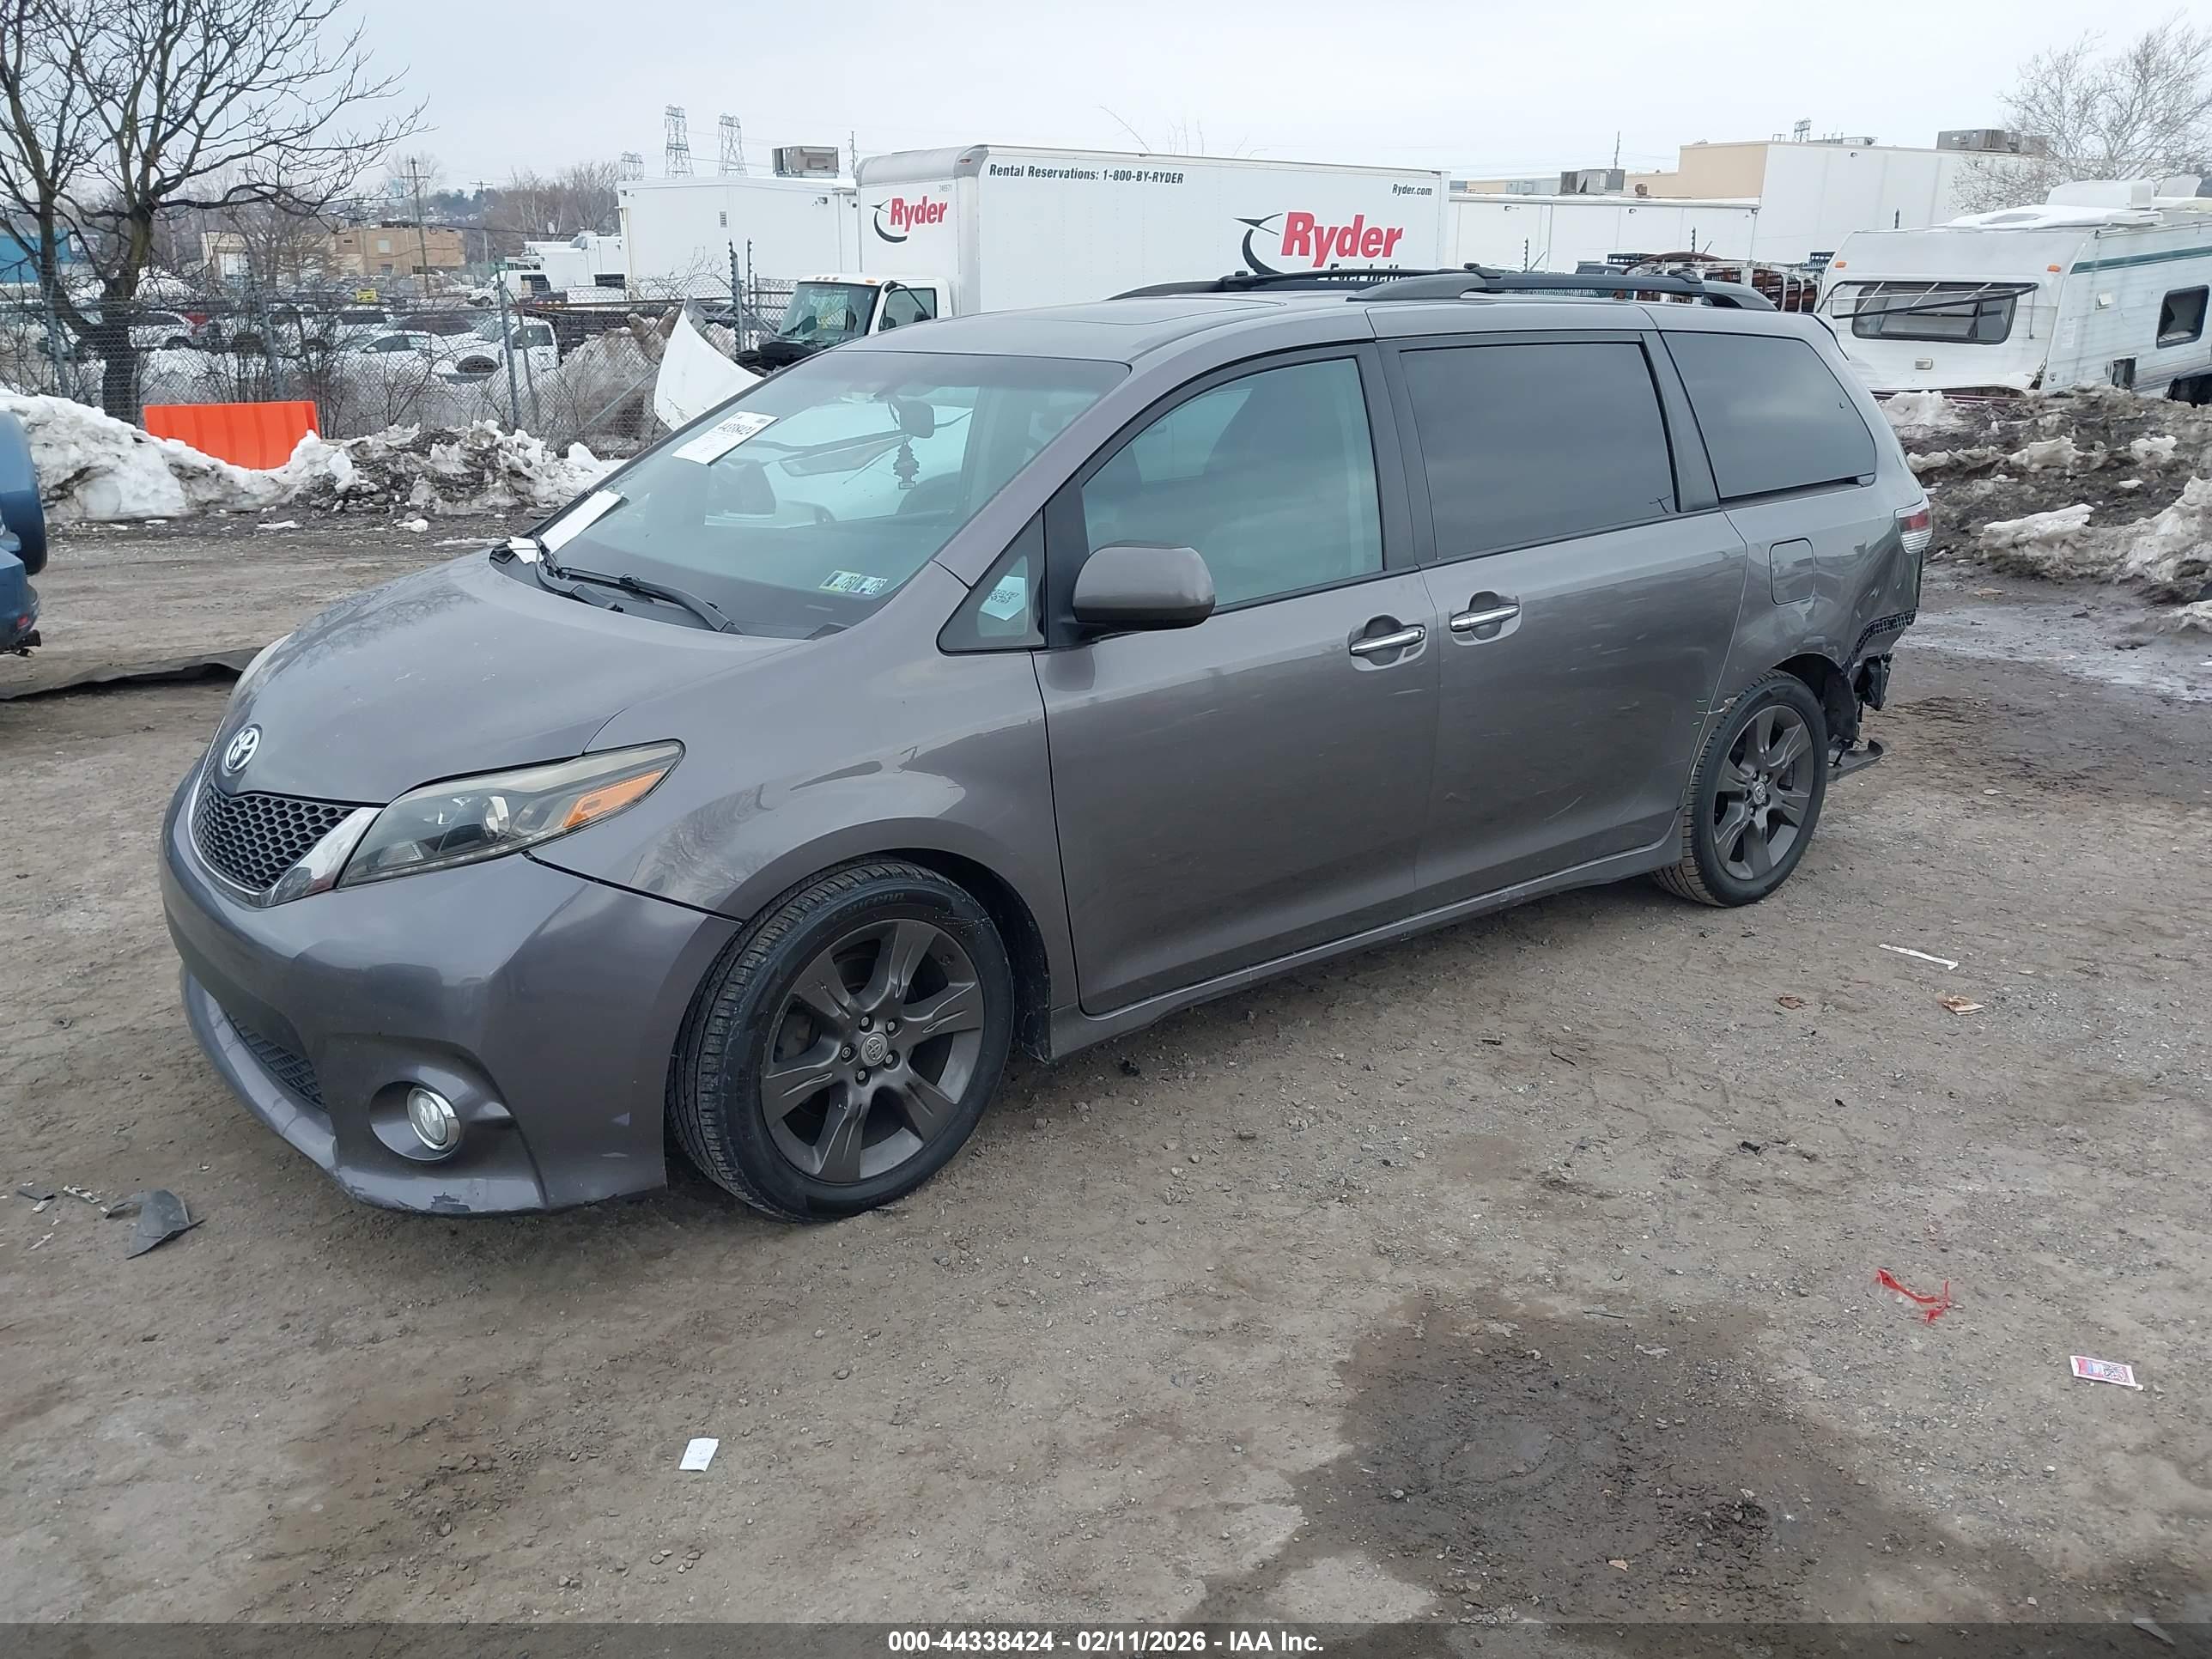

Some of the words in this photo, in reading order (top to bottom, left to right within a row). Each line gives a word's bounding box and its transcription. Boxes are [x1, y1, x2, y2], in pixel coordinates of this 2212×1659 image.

[989, 164, 1024, 177] Rental
[1028, 165, 1099, 180] Reservations:
[1103, 168, 1184, 184] 1-800-BY-RYDER
[1392, 183, 1433, 197] Ryder.com
[890, 195, 948, 233] Ryder
[1280, 211, 1404, 268] Ryder
